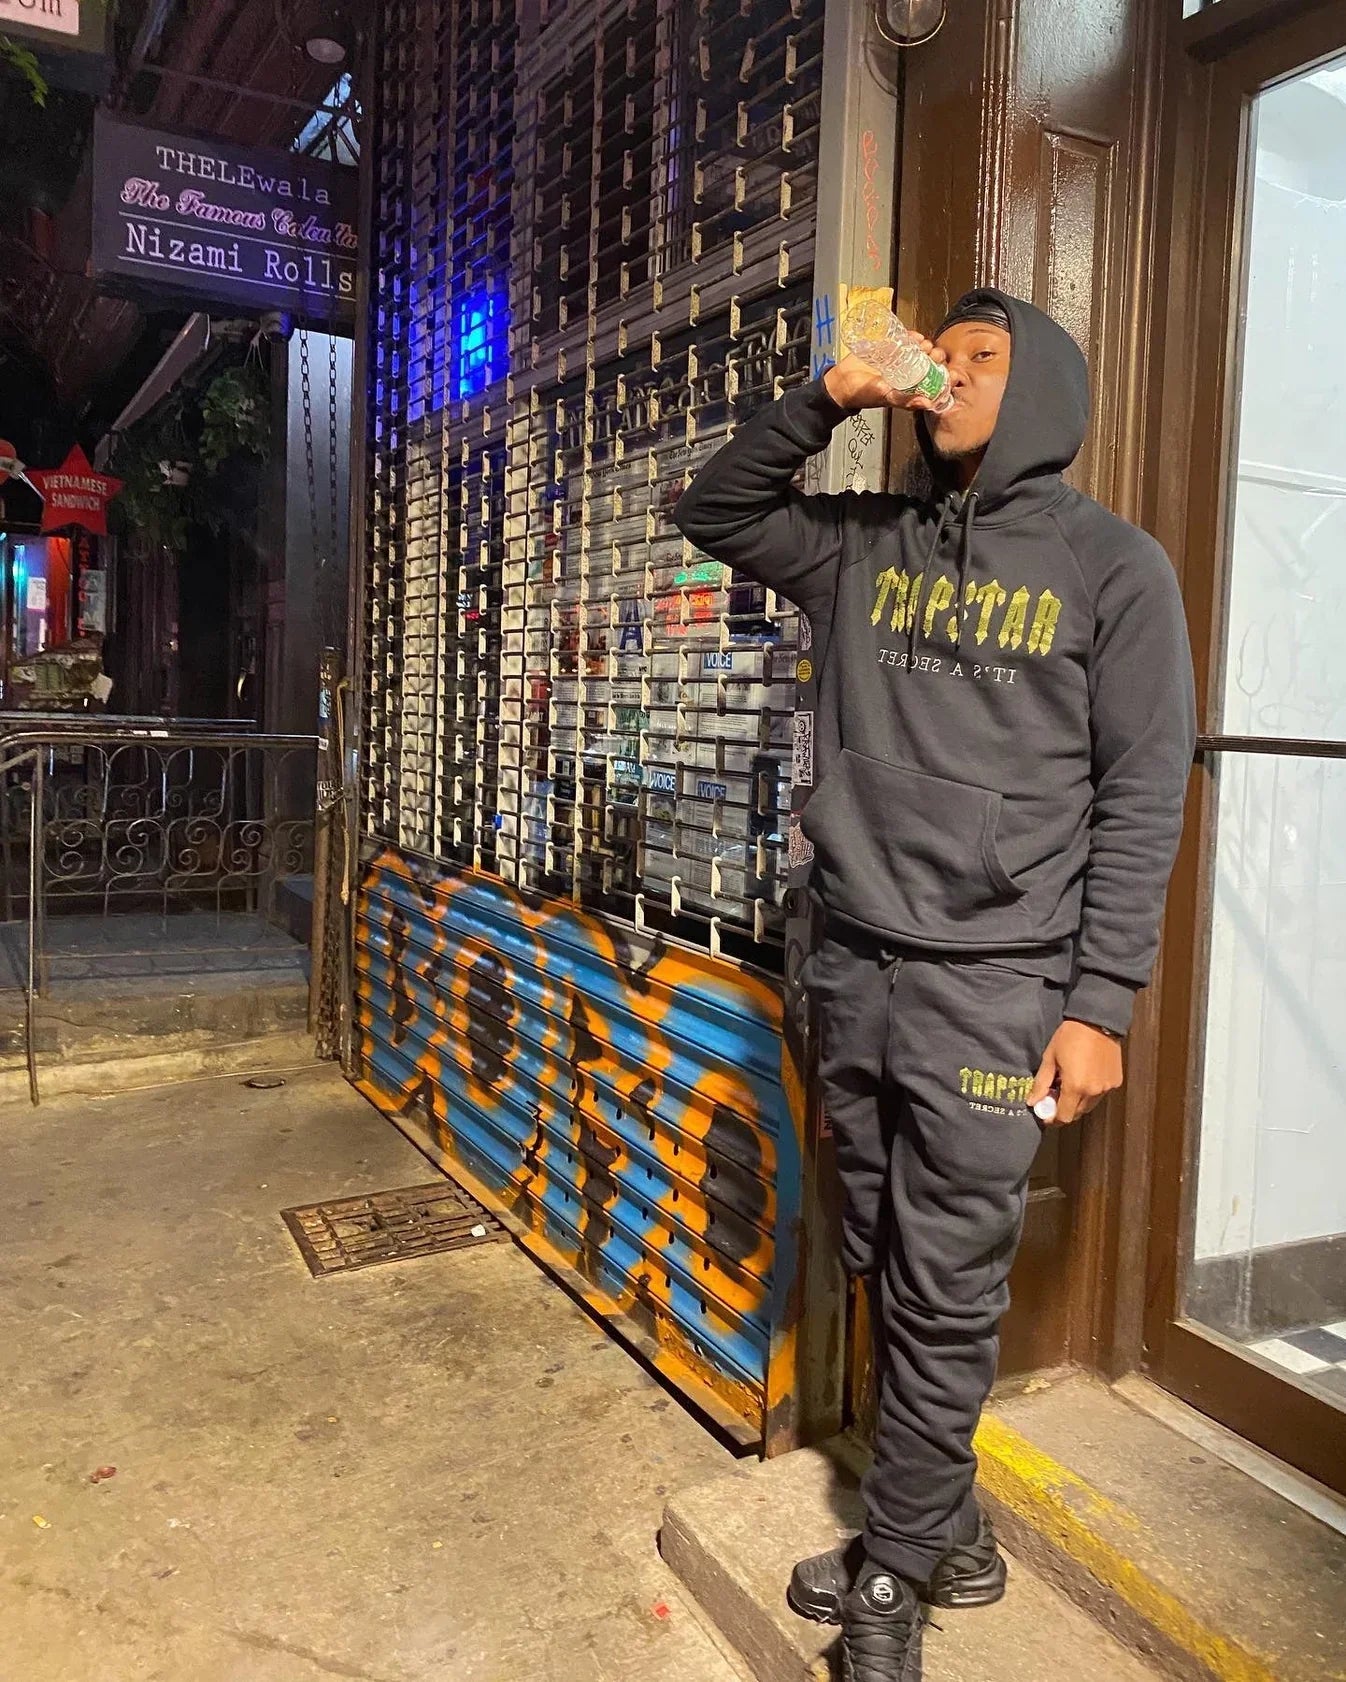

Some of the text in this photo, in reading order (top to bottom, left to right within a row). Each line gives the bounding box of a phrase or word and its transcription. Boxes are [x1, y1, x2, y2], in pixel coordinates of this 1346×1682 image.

[156, 146, 330, 205] THELEwala
[120, 176, 171, 211] The
[176, 188, 265, 231] Famous
[125, 222, 353, 292] Nizami Rolls
[43, 475, 107, 496] VIETNAMESE
[52, 492, 101, 511] SANDWICH
[706, 652, 731, 669] VOICE
[652, 771, 677, 791] VOICE
